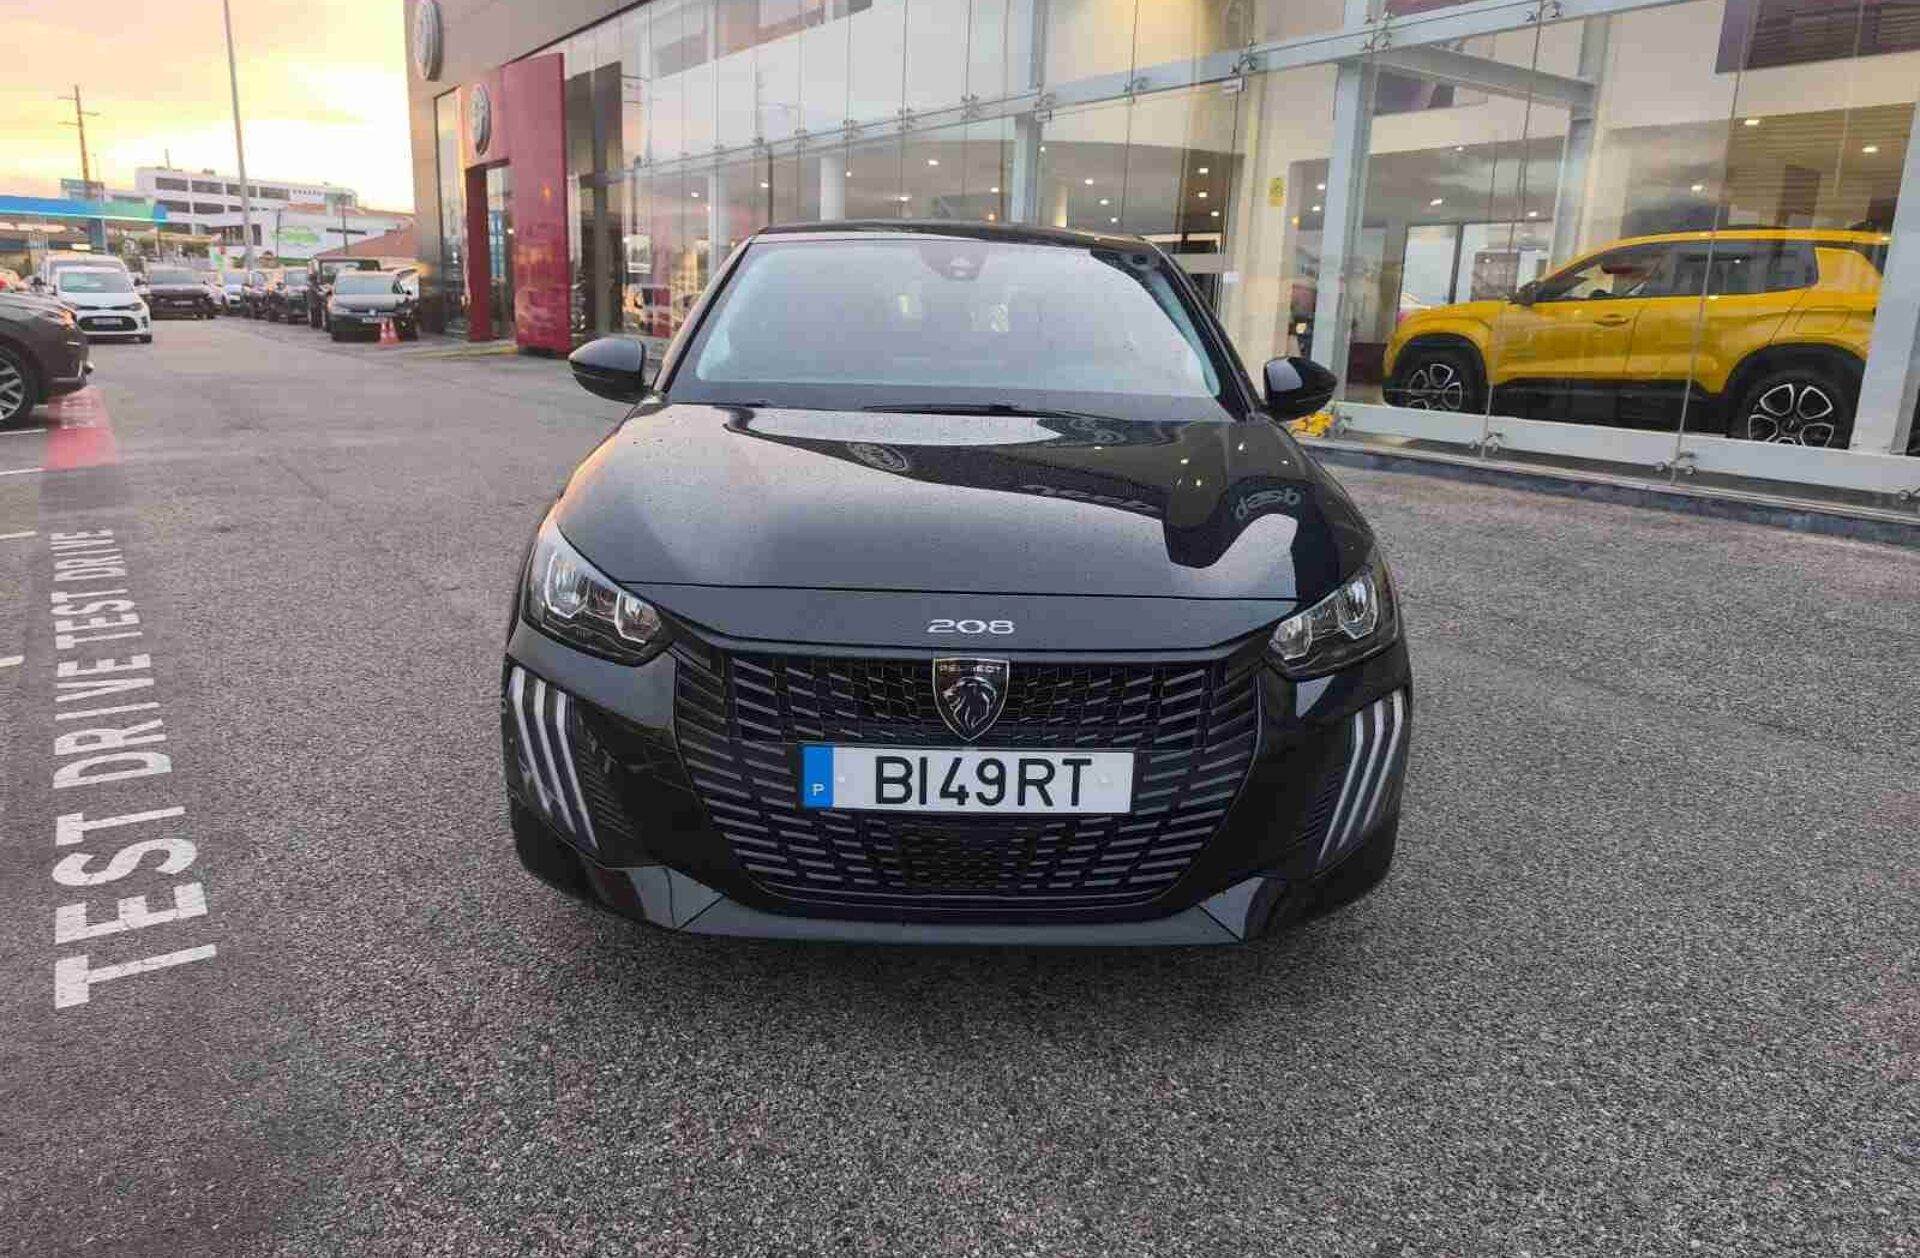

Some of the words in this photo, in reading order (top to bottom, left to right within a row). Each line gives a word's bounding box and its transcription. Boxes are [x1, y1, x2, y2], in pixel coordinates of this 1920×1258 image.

[50, 528, 127, 582] DRIVE
[50, 588, 144, 650] TEST
[926, 618, 1016, 635] 208
[52, 653, 173, 789] DRIVE
[811, 783, 825, 797] P
[53, 805, 218, 1010] TEST
